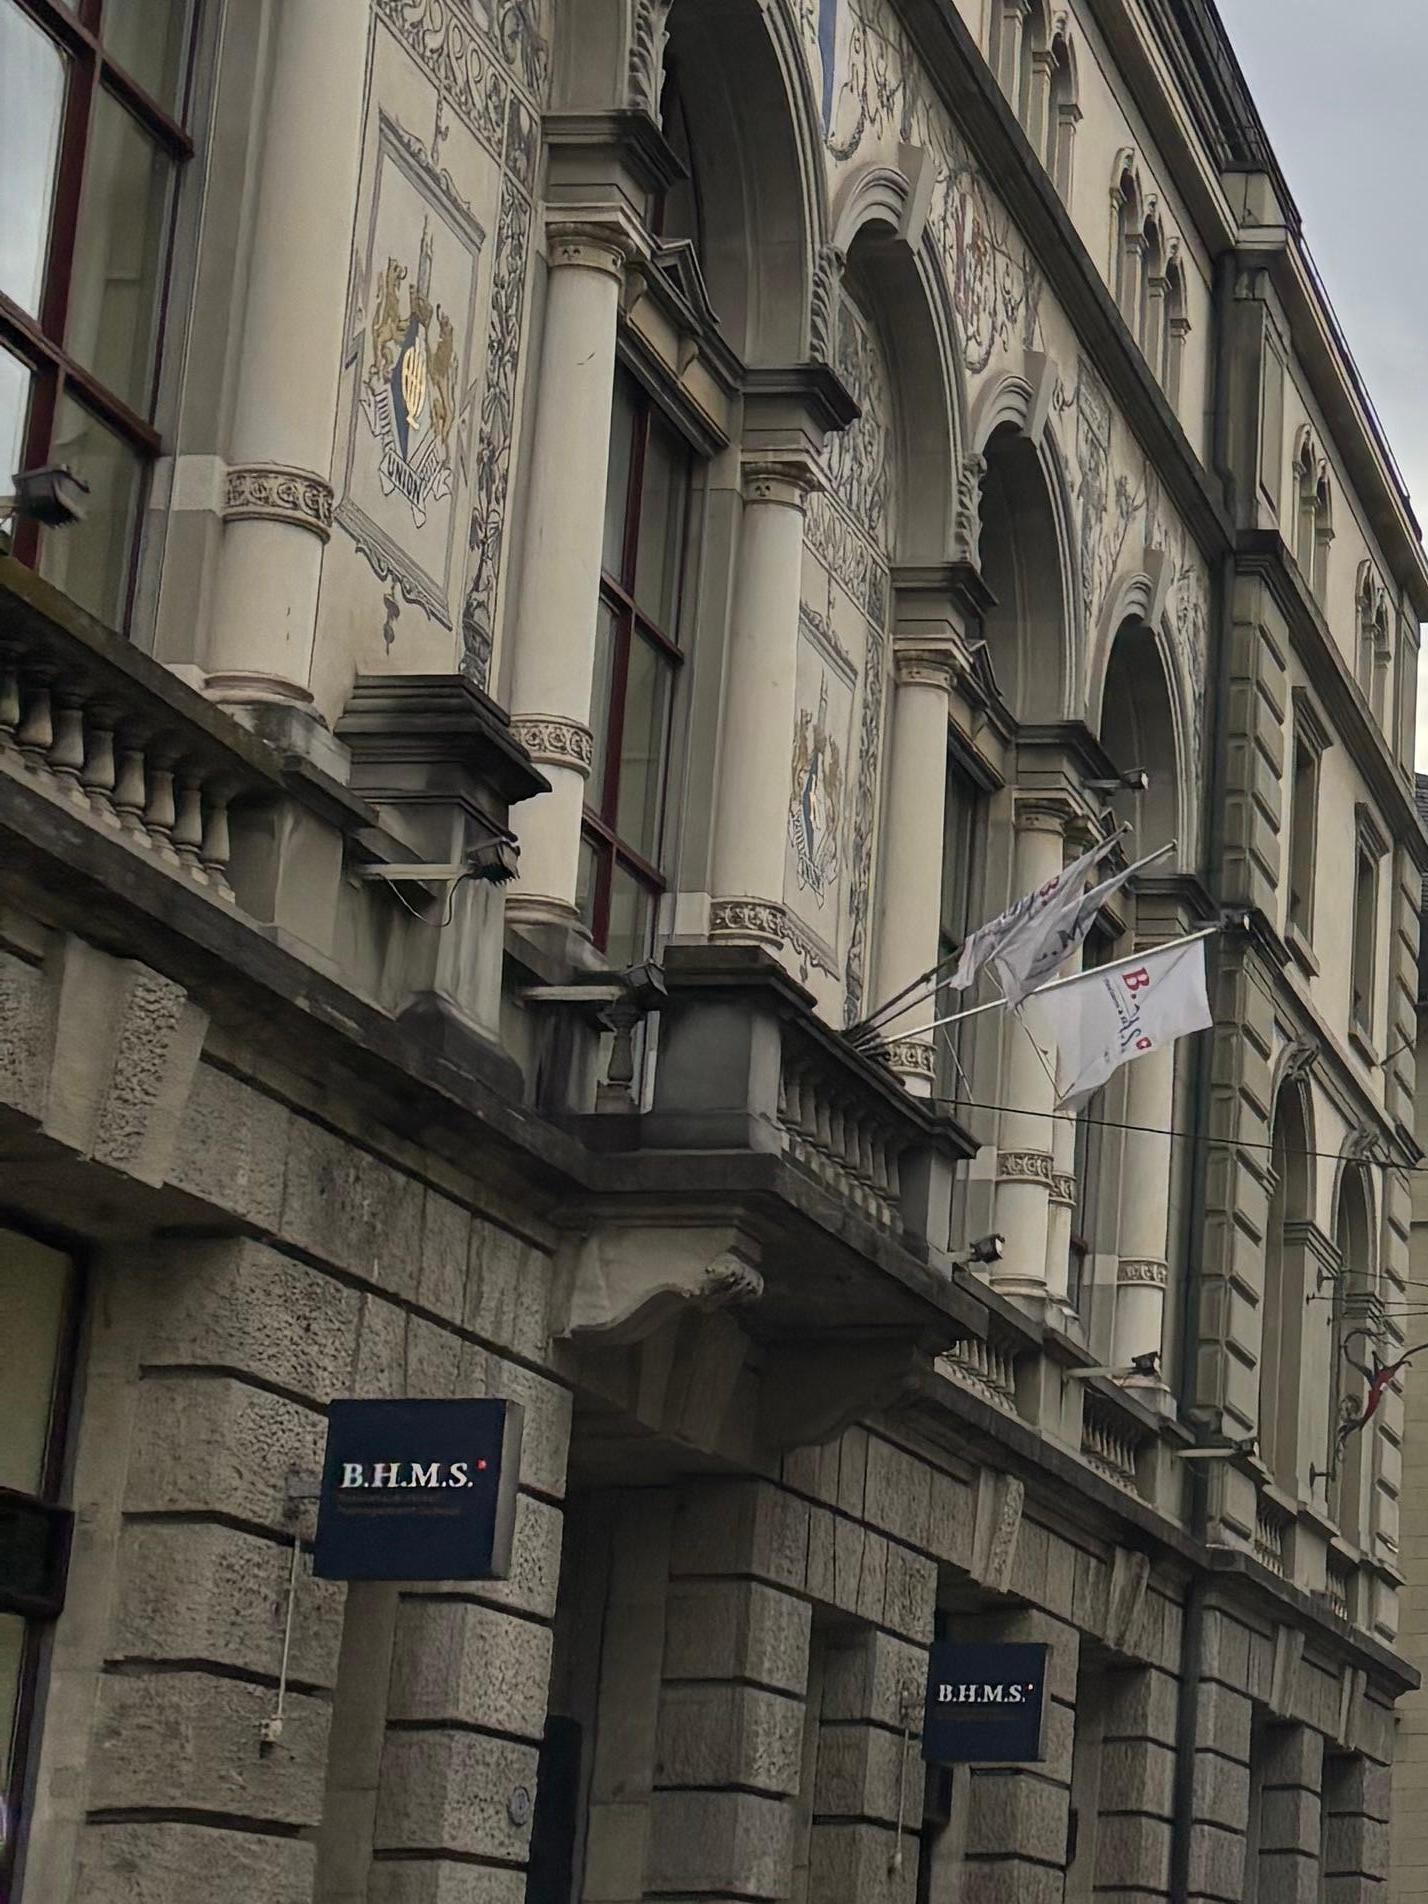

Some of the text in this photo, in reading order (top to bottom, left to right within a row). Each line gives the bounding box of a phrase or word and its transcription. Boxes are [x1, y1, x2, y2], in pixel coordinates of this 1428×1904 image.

[388, 455, 422, 504] UNION
[340, 1462, 474, 1488] B.H.M.S.
[938, 1683, 1026, 1703] B.H.M.S.
